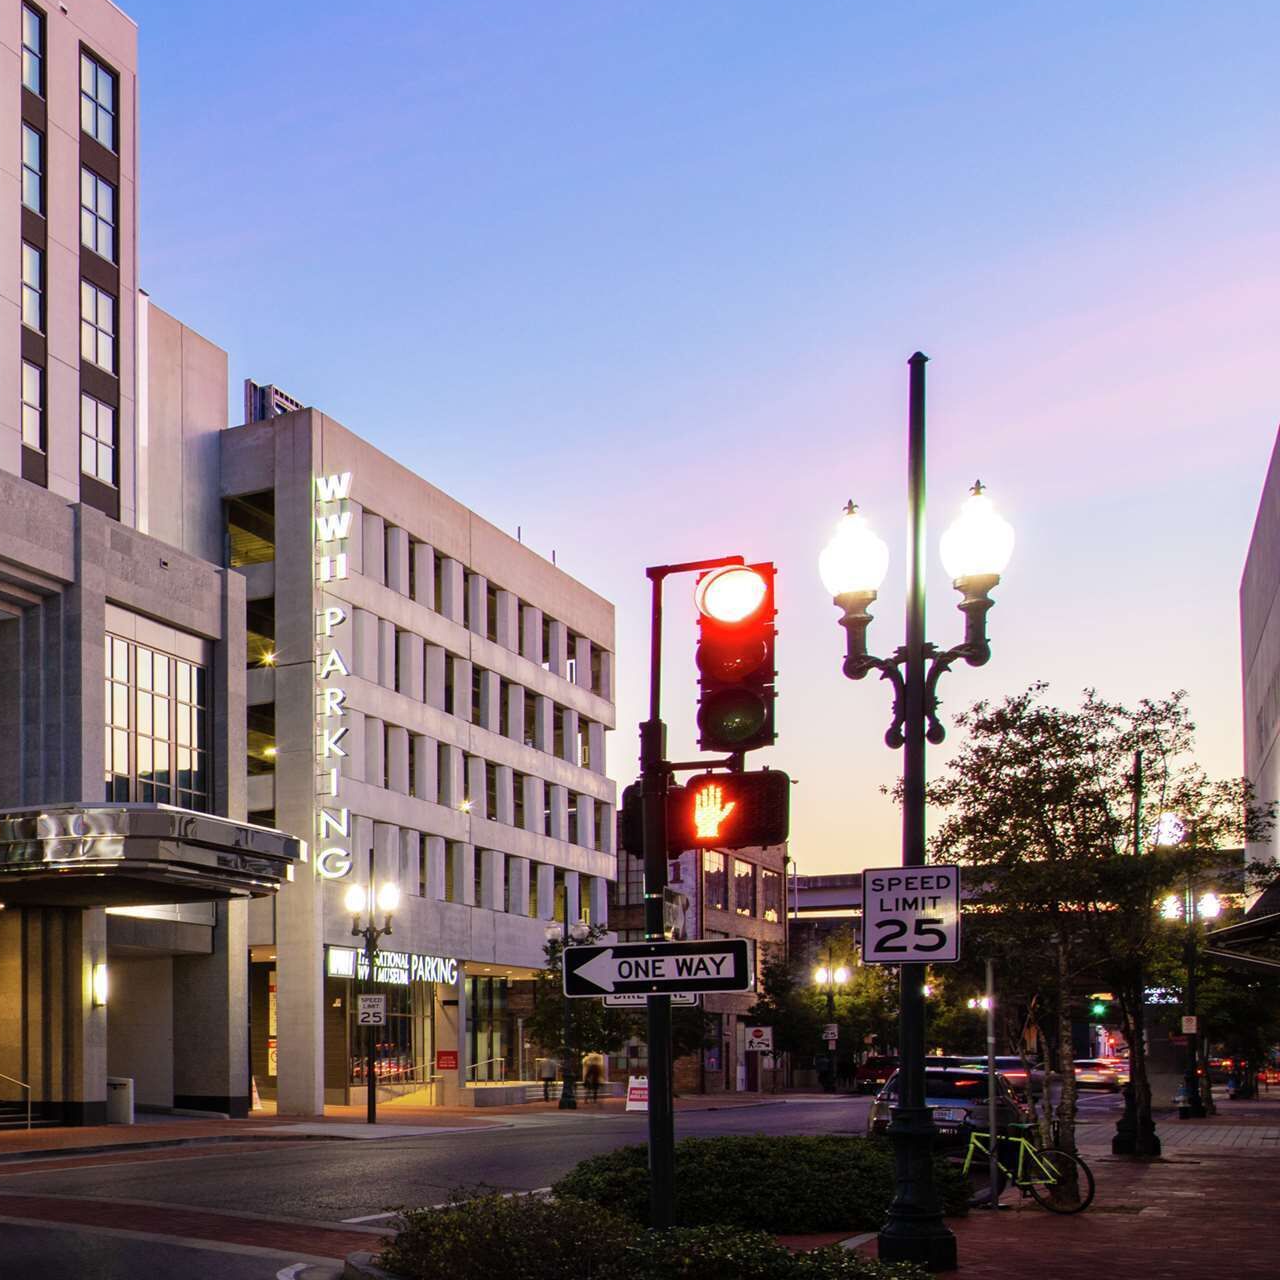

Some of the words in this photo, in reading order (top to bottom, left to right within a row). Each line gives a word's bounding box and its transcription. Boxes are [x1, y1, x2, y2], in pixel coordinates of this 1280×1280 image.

[316, 471, 352, 583] WWII
[317, 606, 353, 880] PARKING
[871, 875, 951, 892] SPEED
[880, 896, 942, 912] LIMIT
[873, 918, 947, 953] 25
[411, 954, 458, 985] PARKING
[618, 959, 665, 979] ONE
[675, 956, 727, 977] WAY
[360, 1012, 383, 1023] 25
